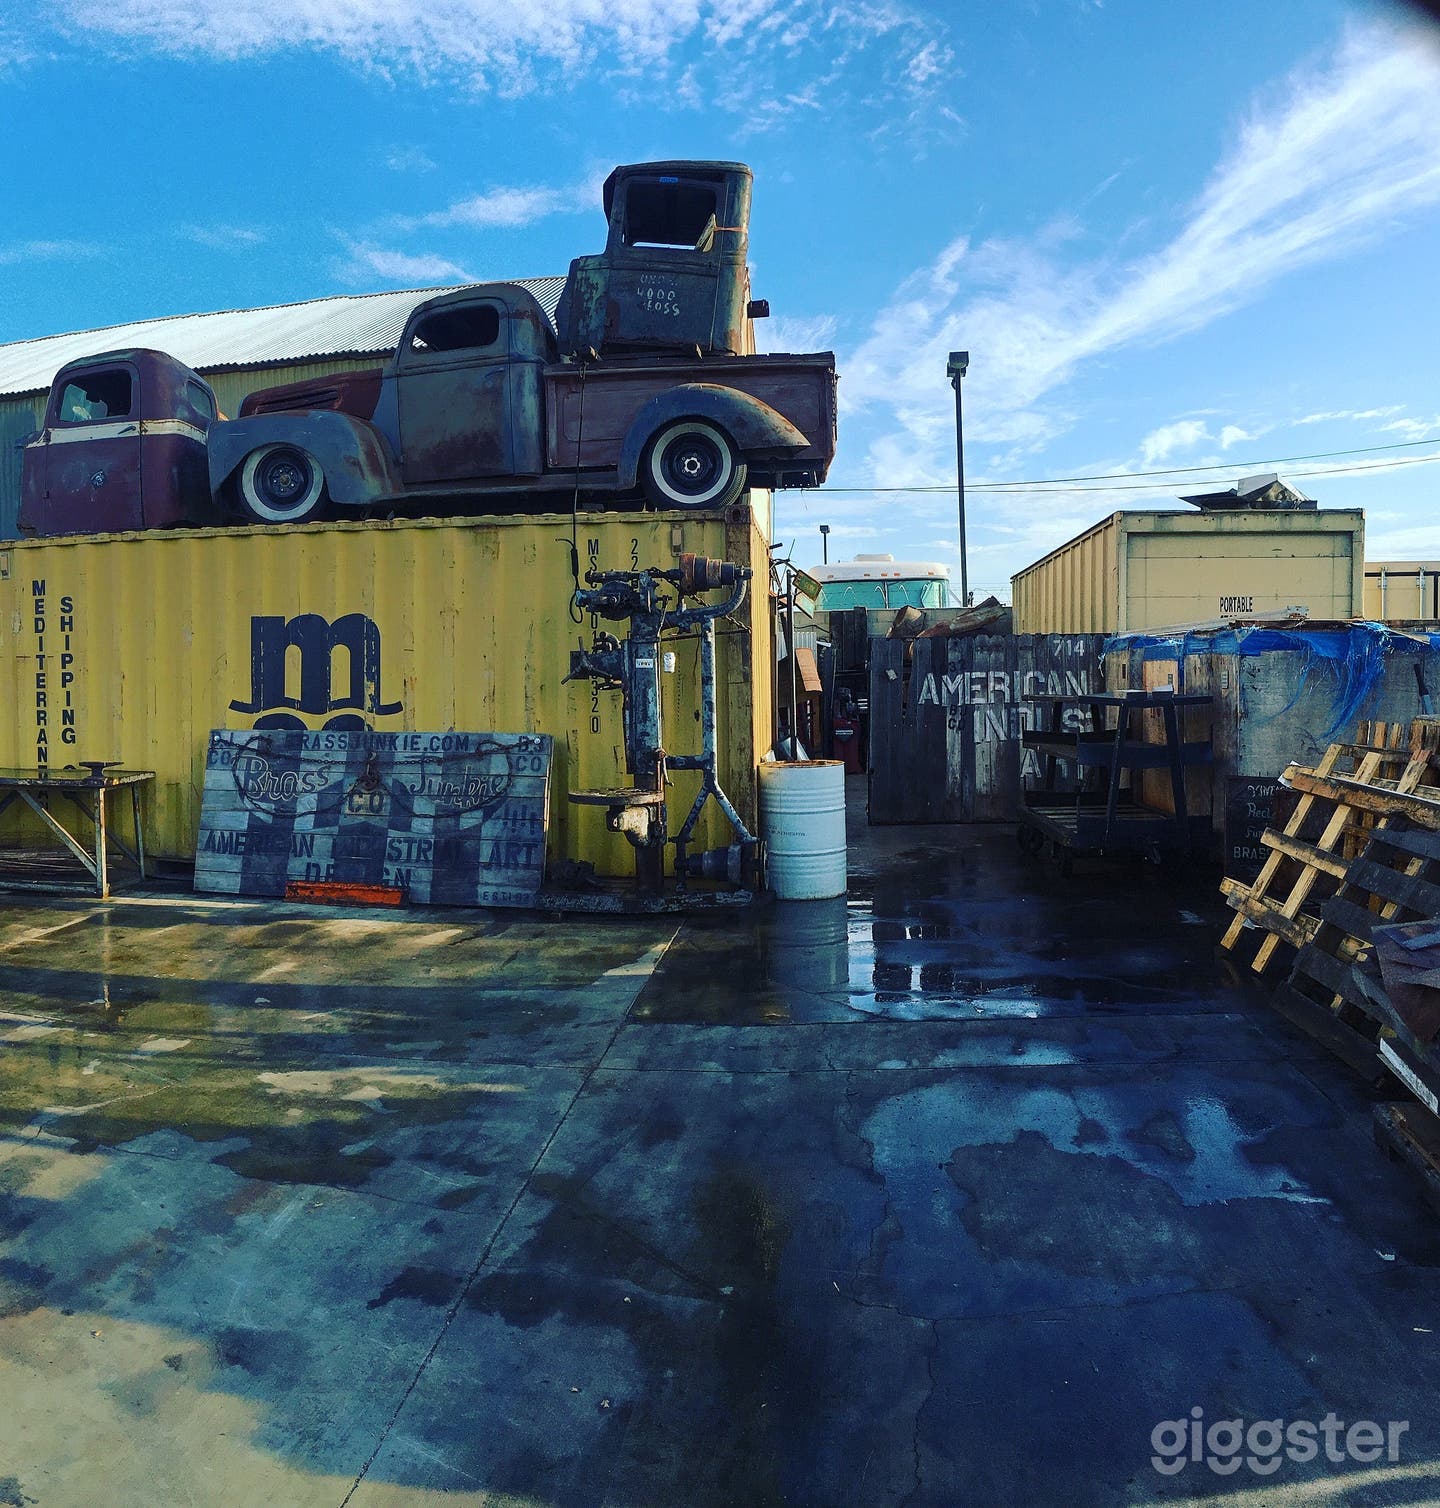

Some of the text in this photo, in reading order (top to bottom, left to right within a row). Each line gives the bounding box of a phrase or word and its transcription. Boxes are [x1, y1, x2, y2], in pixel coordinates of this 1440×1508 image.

[1219, 596, 1253, 613] PORTABLE
[1053, 639, 1085, 657] 714
[59, 596, 76, 744] SHIPPING
[917, 670, 1088, 707] AMERICAN
[209, 750, 232, 766] CO
[515, 755, 542, 773] CO
[231, 754, 332, 802] Brass
[404, 751, 506, 809] Junkie
[348, 790, 385, 813] CO
[486, 840, 539, 870] ART
